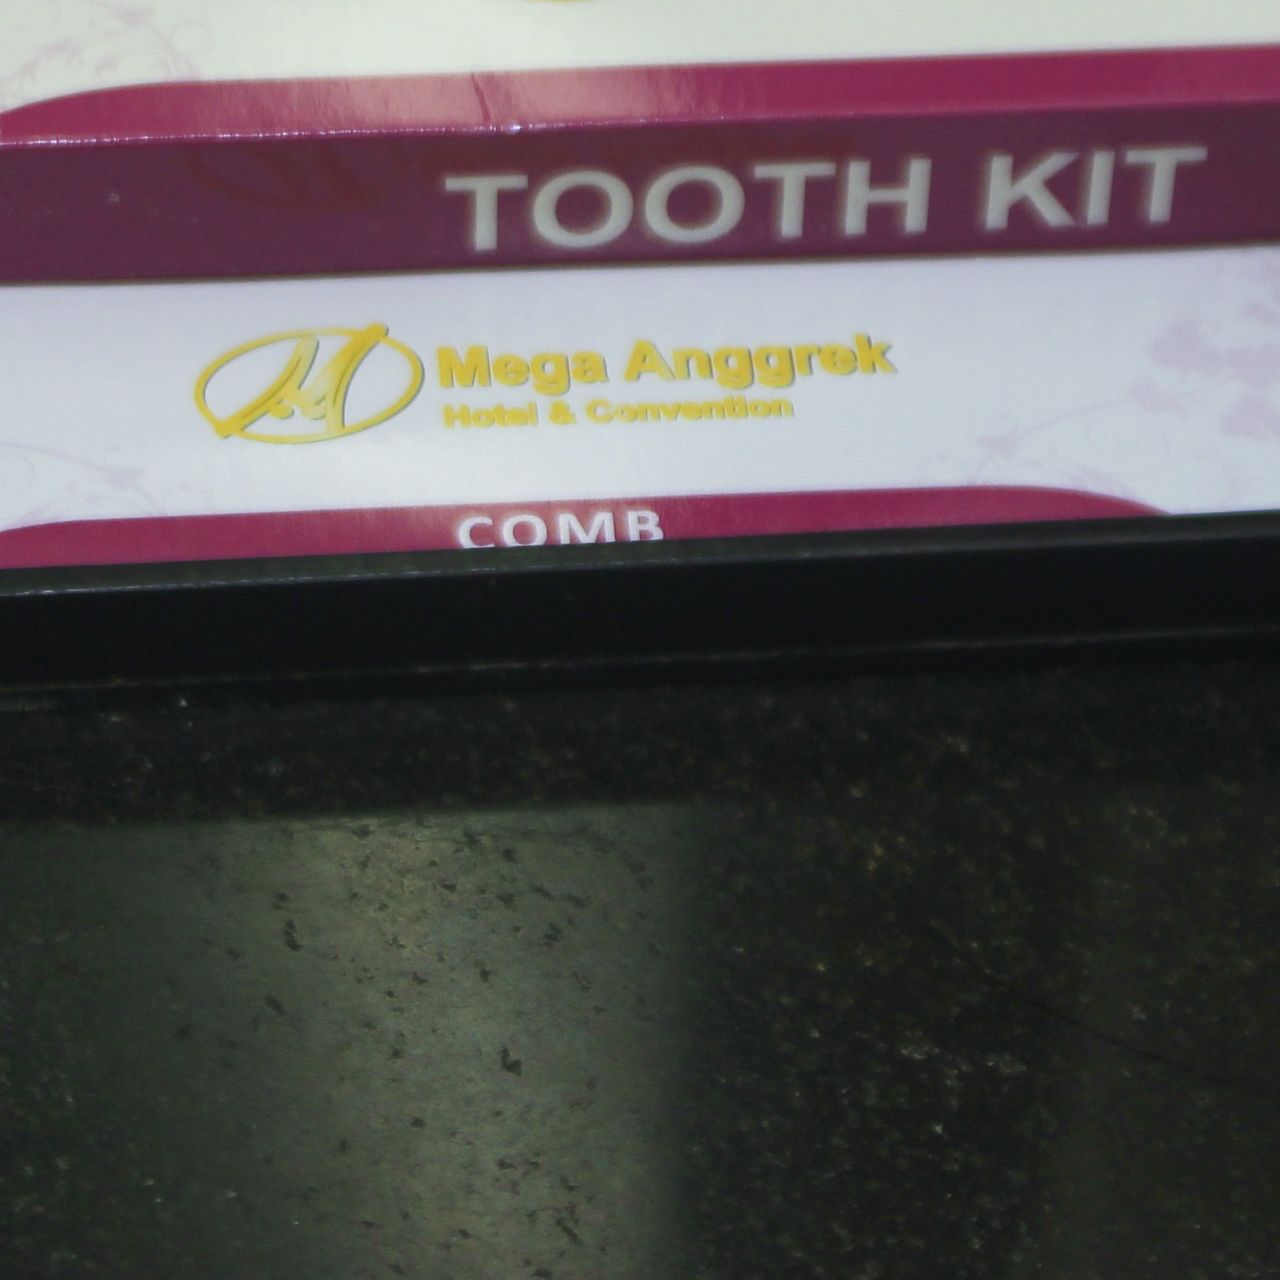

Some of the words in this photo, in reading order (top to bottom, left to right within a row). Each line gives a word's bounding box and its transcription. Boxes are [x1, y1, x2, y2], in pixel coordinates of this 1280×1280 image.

[444, 157, 931, 254] TOOTH
[984, 145, 1208, 232] KIT
[437, 344, 609, 397] Mega
[625, 333, 898, 389] Anggrek
[442, 401, 538, 429] Hotel
[549, 400, 578, 425] &
[586, 395, 795, 424] Convention
[457, 509, 665, 550] COMB
